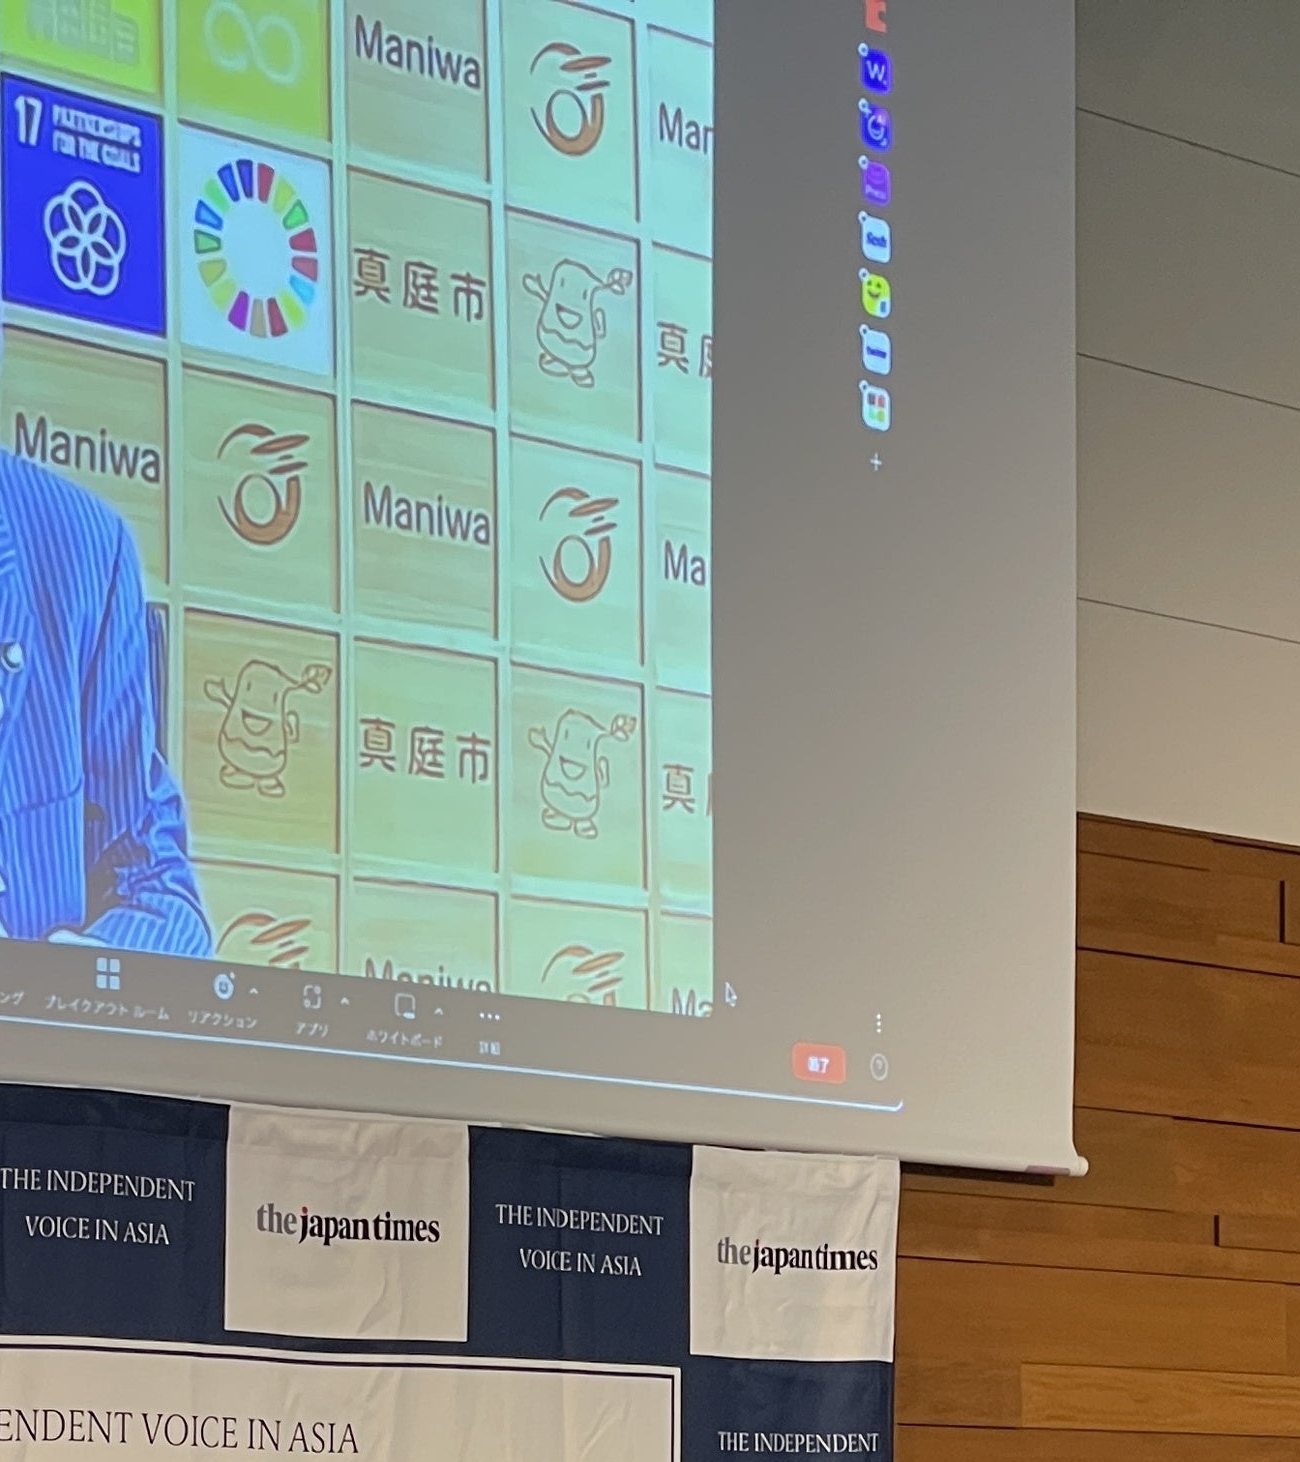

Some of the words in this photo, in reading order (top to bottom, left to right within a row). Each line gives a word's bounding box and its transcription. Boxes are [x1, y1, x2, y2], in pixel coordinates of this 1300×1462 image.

[355, 14, 482, 90] Maniwa
[14, 95, 42, 146] 17
[352, 247, 487, 322] 真庭市
[14, 412, 161, 485] Maniwa
[363, 481, 491, 546] Maniwa
[359, 718, 491, 784] 真庭市
[0, 1165, 42, 1192] THE
[46, 1168, 196, 1203] INDEPENDENT
[24, 1213, 90, 1241] VOICE
[94, 1217, 120, 1242] IN
[122, 1218, 171, 1247] ASIA
[494, 1202, 534, 1228] THE
[536, 1205, 665, 1237] INDEPENDENT
[518, 1247, 573, 1274] VOICE
[575, 1250, 597, 1275] IN
[599, 1251, 642, 1278] ASIA
[139, 1412, 241, 1451] VOICE
[247, 1415, 283, 1452] IN
[288, 1419, 361, 1455] ASIA
[716, 1429, 751, 1454] THE
[753, 1430, 880, 1455] INDEPENDENT
